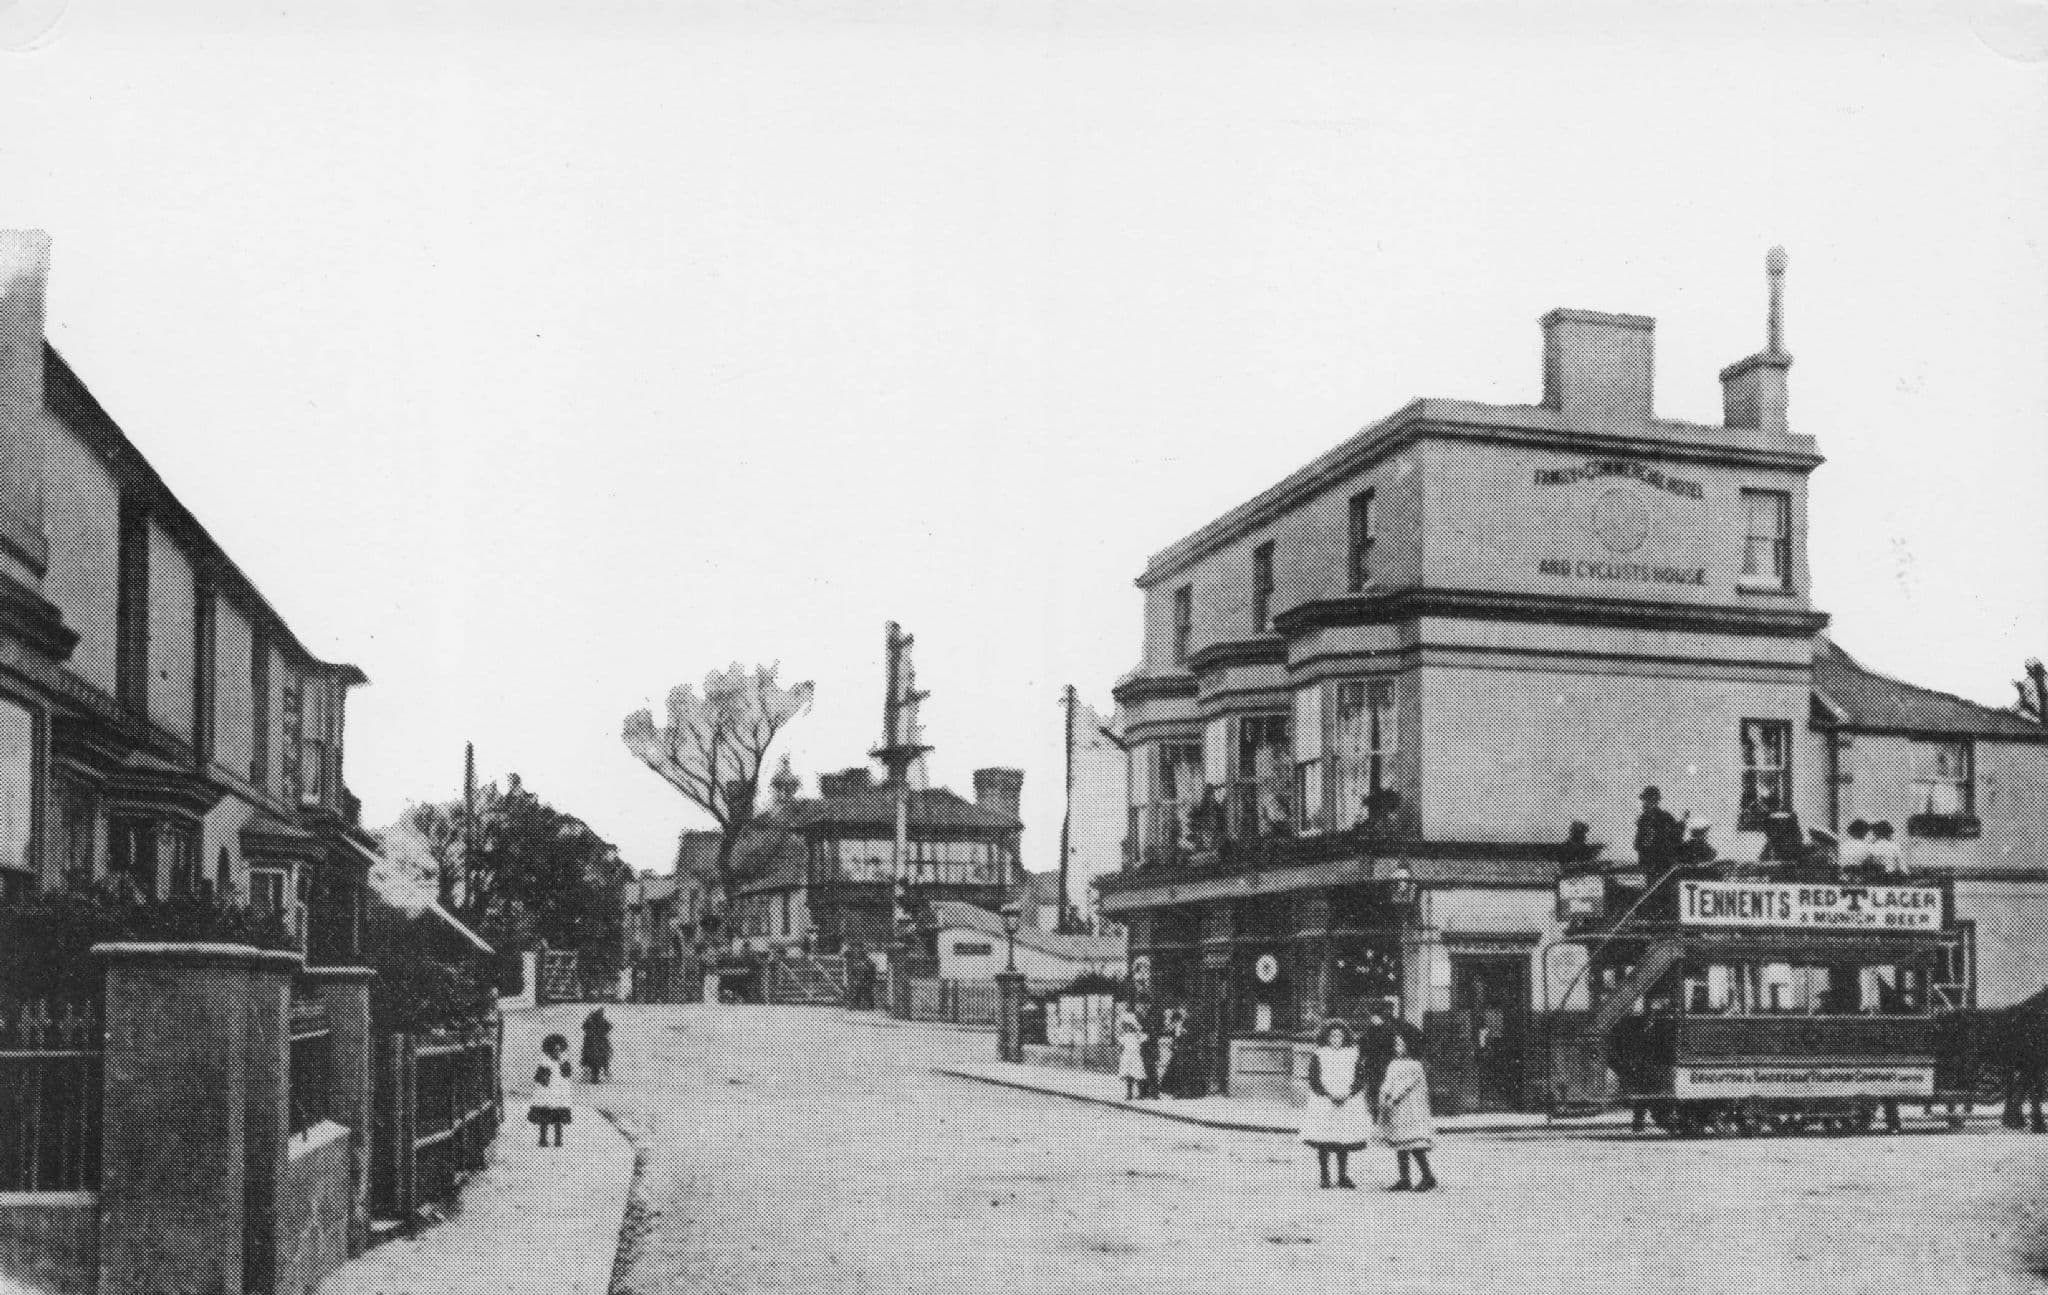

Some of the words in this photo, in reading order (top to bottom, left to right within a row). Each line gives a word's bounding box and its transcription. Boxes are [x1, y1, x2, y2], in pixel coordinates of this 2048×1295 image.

[1667, 476, 1704, 500] HOTEL
[1539, 558, 1571, 577] AND
[1653, 568, 1708, 587] HOUSE
[1799, 888, 1838, 907] RED
[1871, 890, 1937, 909] LAGER
[1813, 912, 1876, 926] MUNICH
[1885, 913, 1930, 927] BEER
